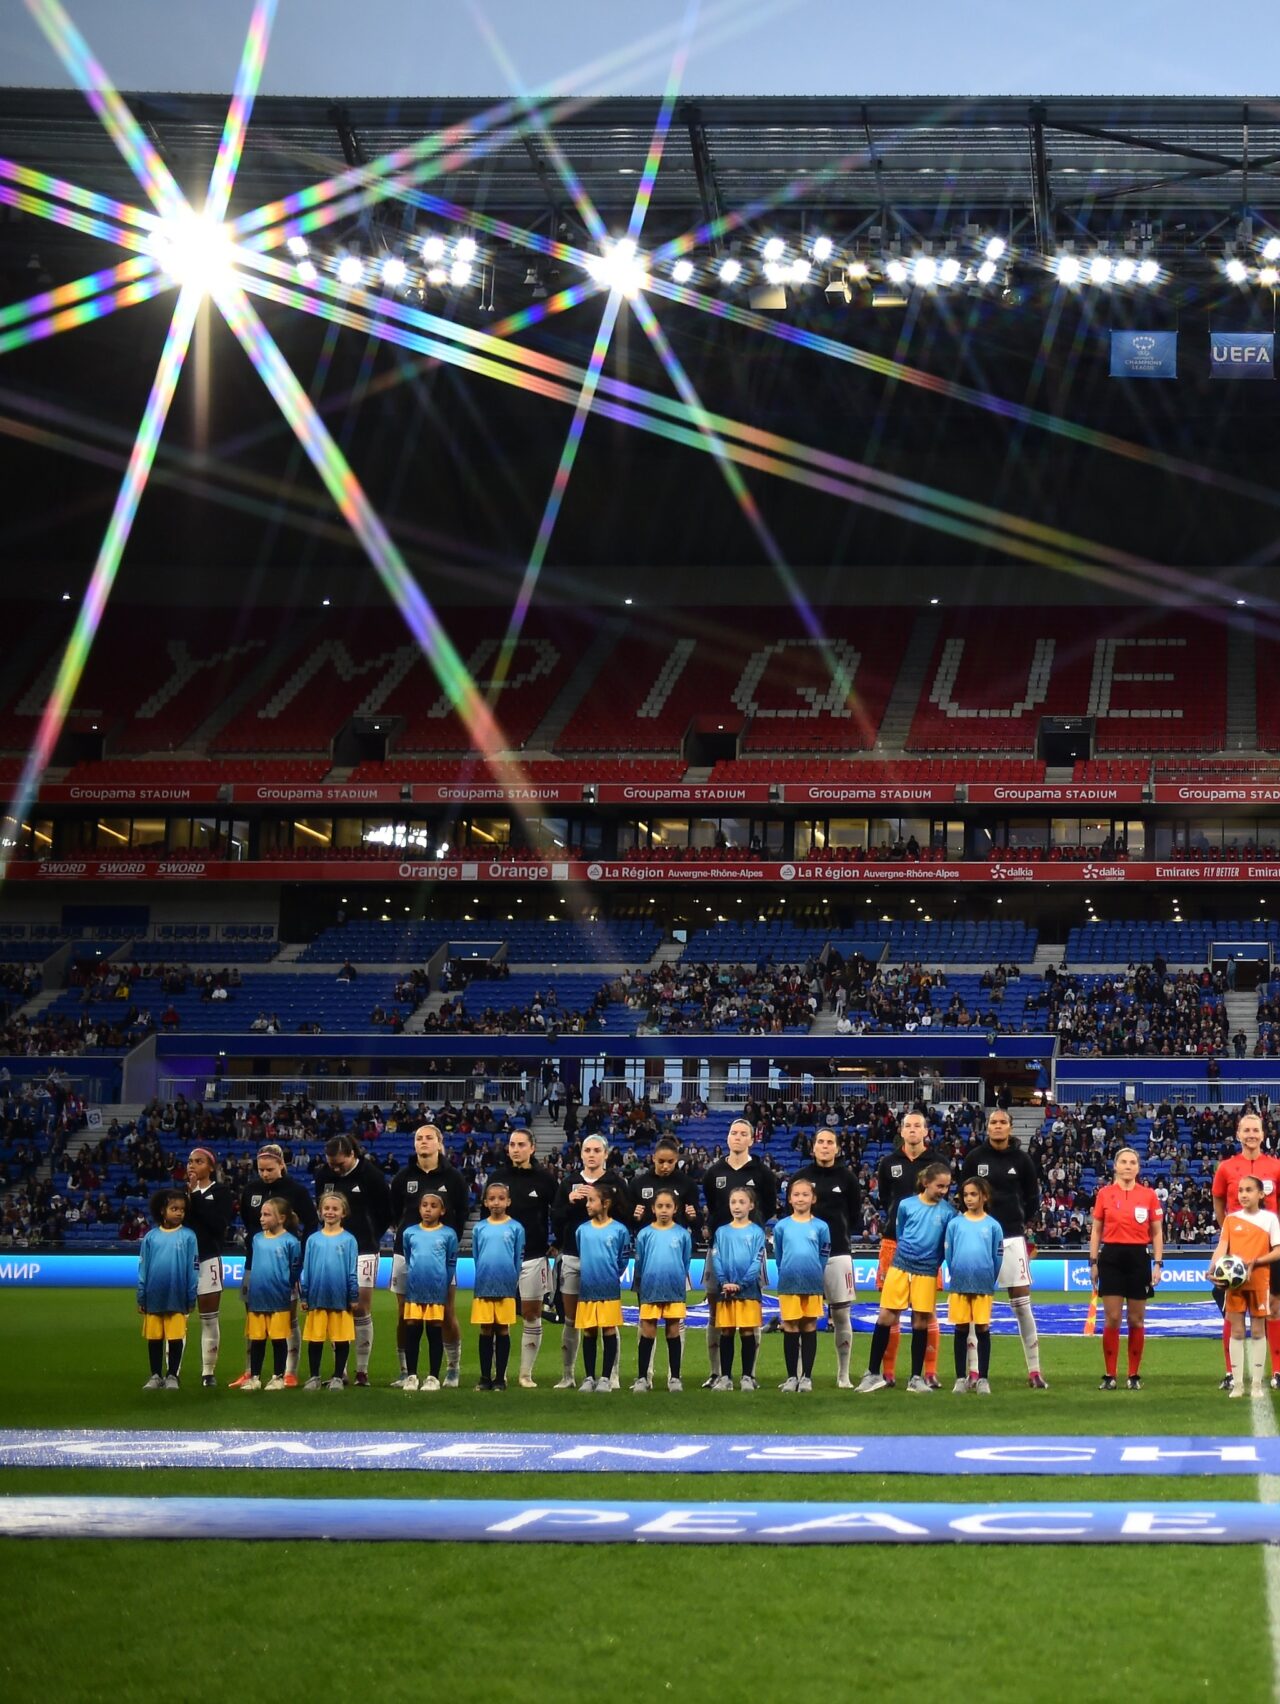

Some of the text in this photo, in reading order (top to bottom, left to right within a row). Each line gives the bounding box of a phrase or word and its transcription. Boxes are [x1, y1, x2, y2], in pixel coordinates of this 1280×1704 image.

[1213, 346, 1270, 362] UEFA
[70, 788, 190, 800] Groupama STADIUM
[257, 788, 378, 800] Groupama STADIUM
[438, 788, 559, 800] Groupama STADIUM
[624, 788, 746, 800] Groupama STADIUM
[808, 788, 932, 800] Groupama STADIUM
[994, 788, 1117, 800] Groupama STADIUM
[1178, 788, 1246, 800] Groupama
[38, 862, 87, 873] SWORD
[97, 862, 146, 873] SWORD
[156, 862, 206, 873] SWORD
[399, 864, 458, 880] Orange
[488, 864, 548, 880] Orange
[605, 866, 763, 880] La Région Auvergne-Rhône-Alpes
[798, 867, 812, 878] La
[864, 868, 959, 878] Auvergne-Rhône-Alpes
[1007, 867, 1033, 876] dalkia
[1099, 867, 1125, 876] dalkia
[1156, 867, 1240, 877] Emirates FLY BETTER
[362, 1261, 372, 1276] 21
[1020, 1258, 1026, 1274] 3
[210, 1265, 218, 1281] 5
[486, 1508, 1226, 1536] PEACE
